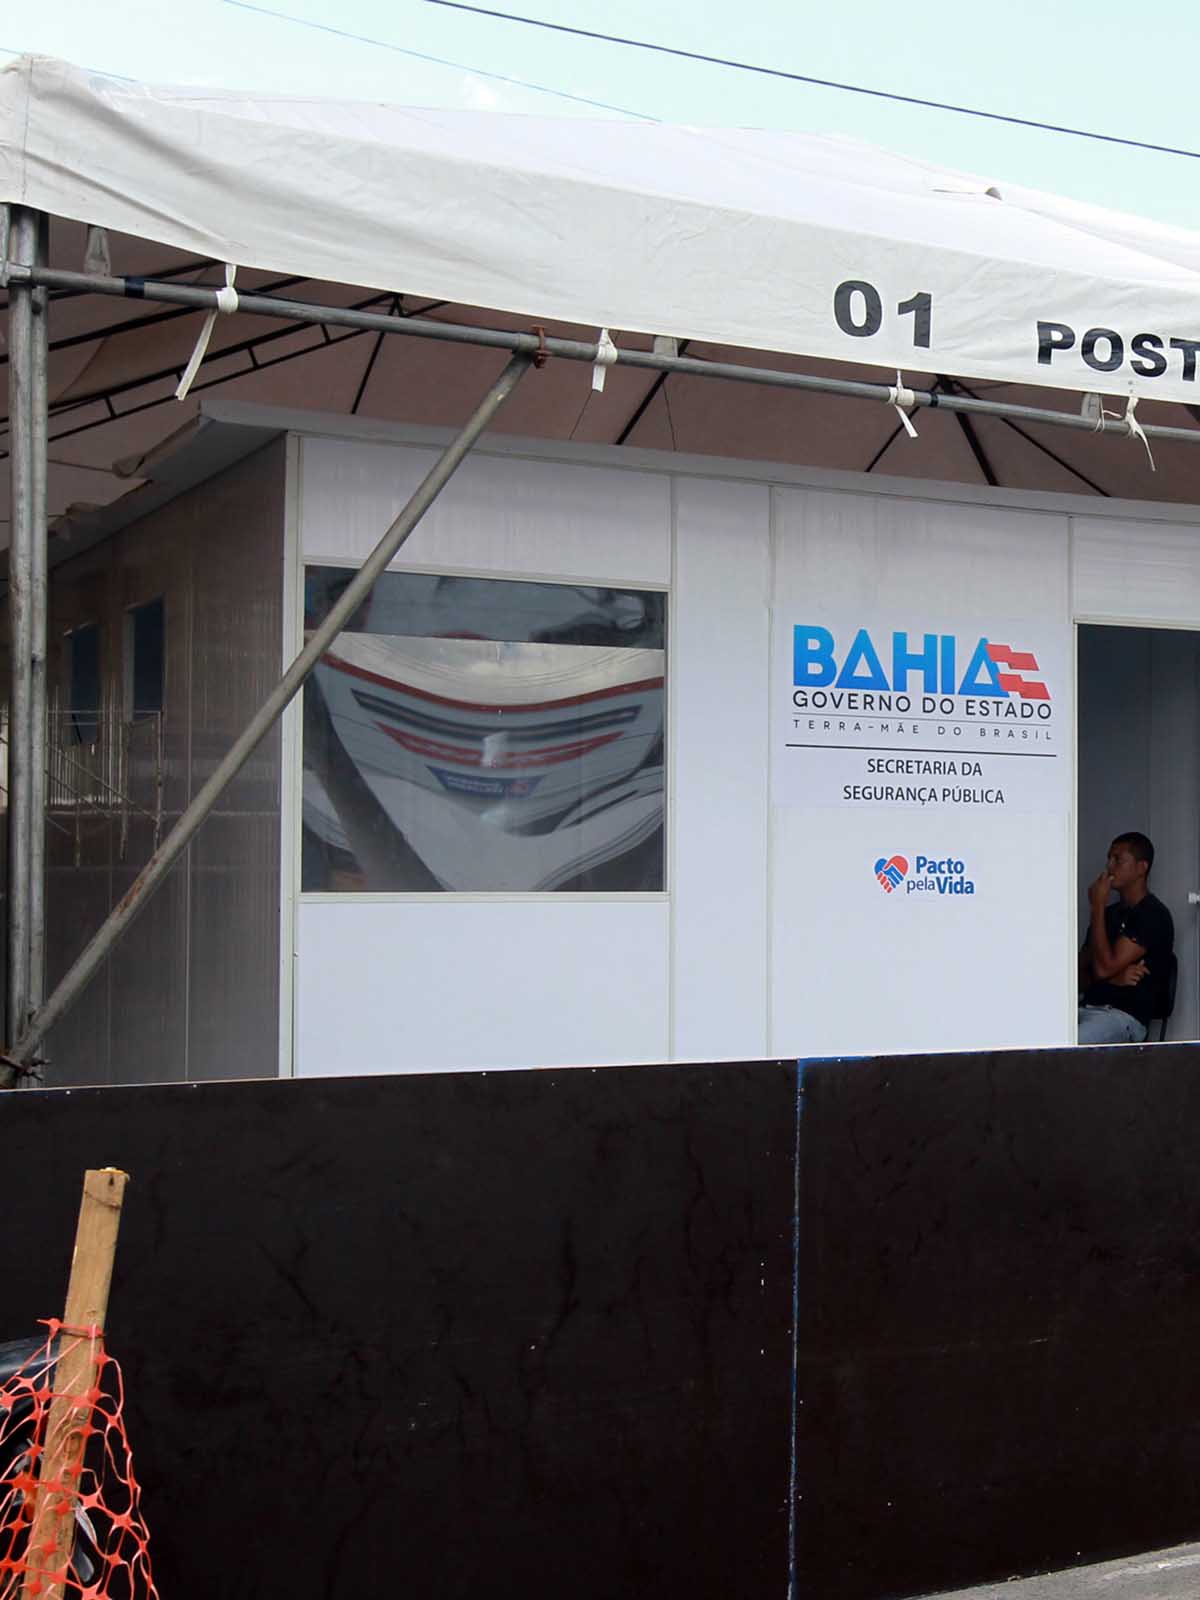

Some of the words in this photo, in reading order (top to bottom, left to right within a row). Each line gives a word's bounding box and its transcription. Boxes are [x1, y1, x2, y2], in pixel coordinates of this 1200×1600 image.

[833, 279, 933, 349] 01
[793, 624, 1010, 698] BAHIA
[792, 690, 912, 713] GOVERNO
[922, 696, 955, 715] DO
[965, 699, 1052, 720] ESTADO
[792, 718, 920, 735] TERRA-MÃE
[937, 725, 963, 737] DO
[979, 727, 1052, 740] BRASIL
[867, 757, 957, 776] SECRETARIA
[961, 761, 983, 777] DA
[843, 785, 938, 806] SEGURANÇA
[942, 784, 1005, 804] PÚBLICA
[915, 855, 965, 876] Pacto
[906, 876, 935, 894] pela
[935, 876, 975, 895] Vida
